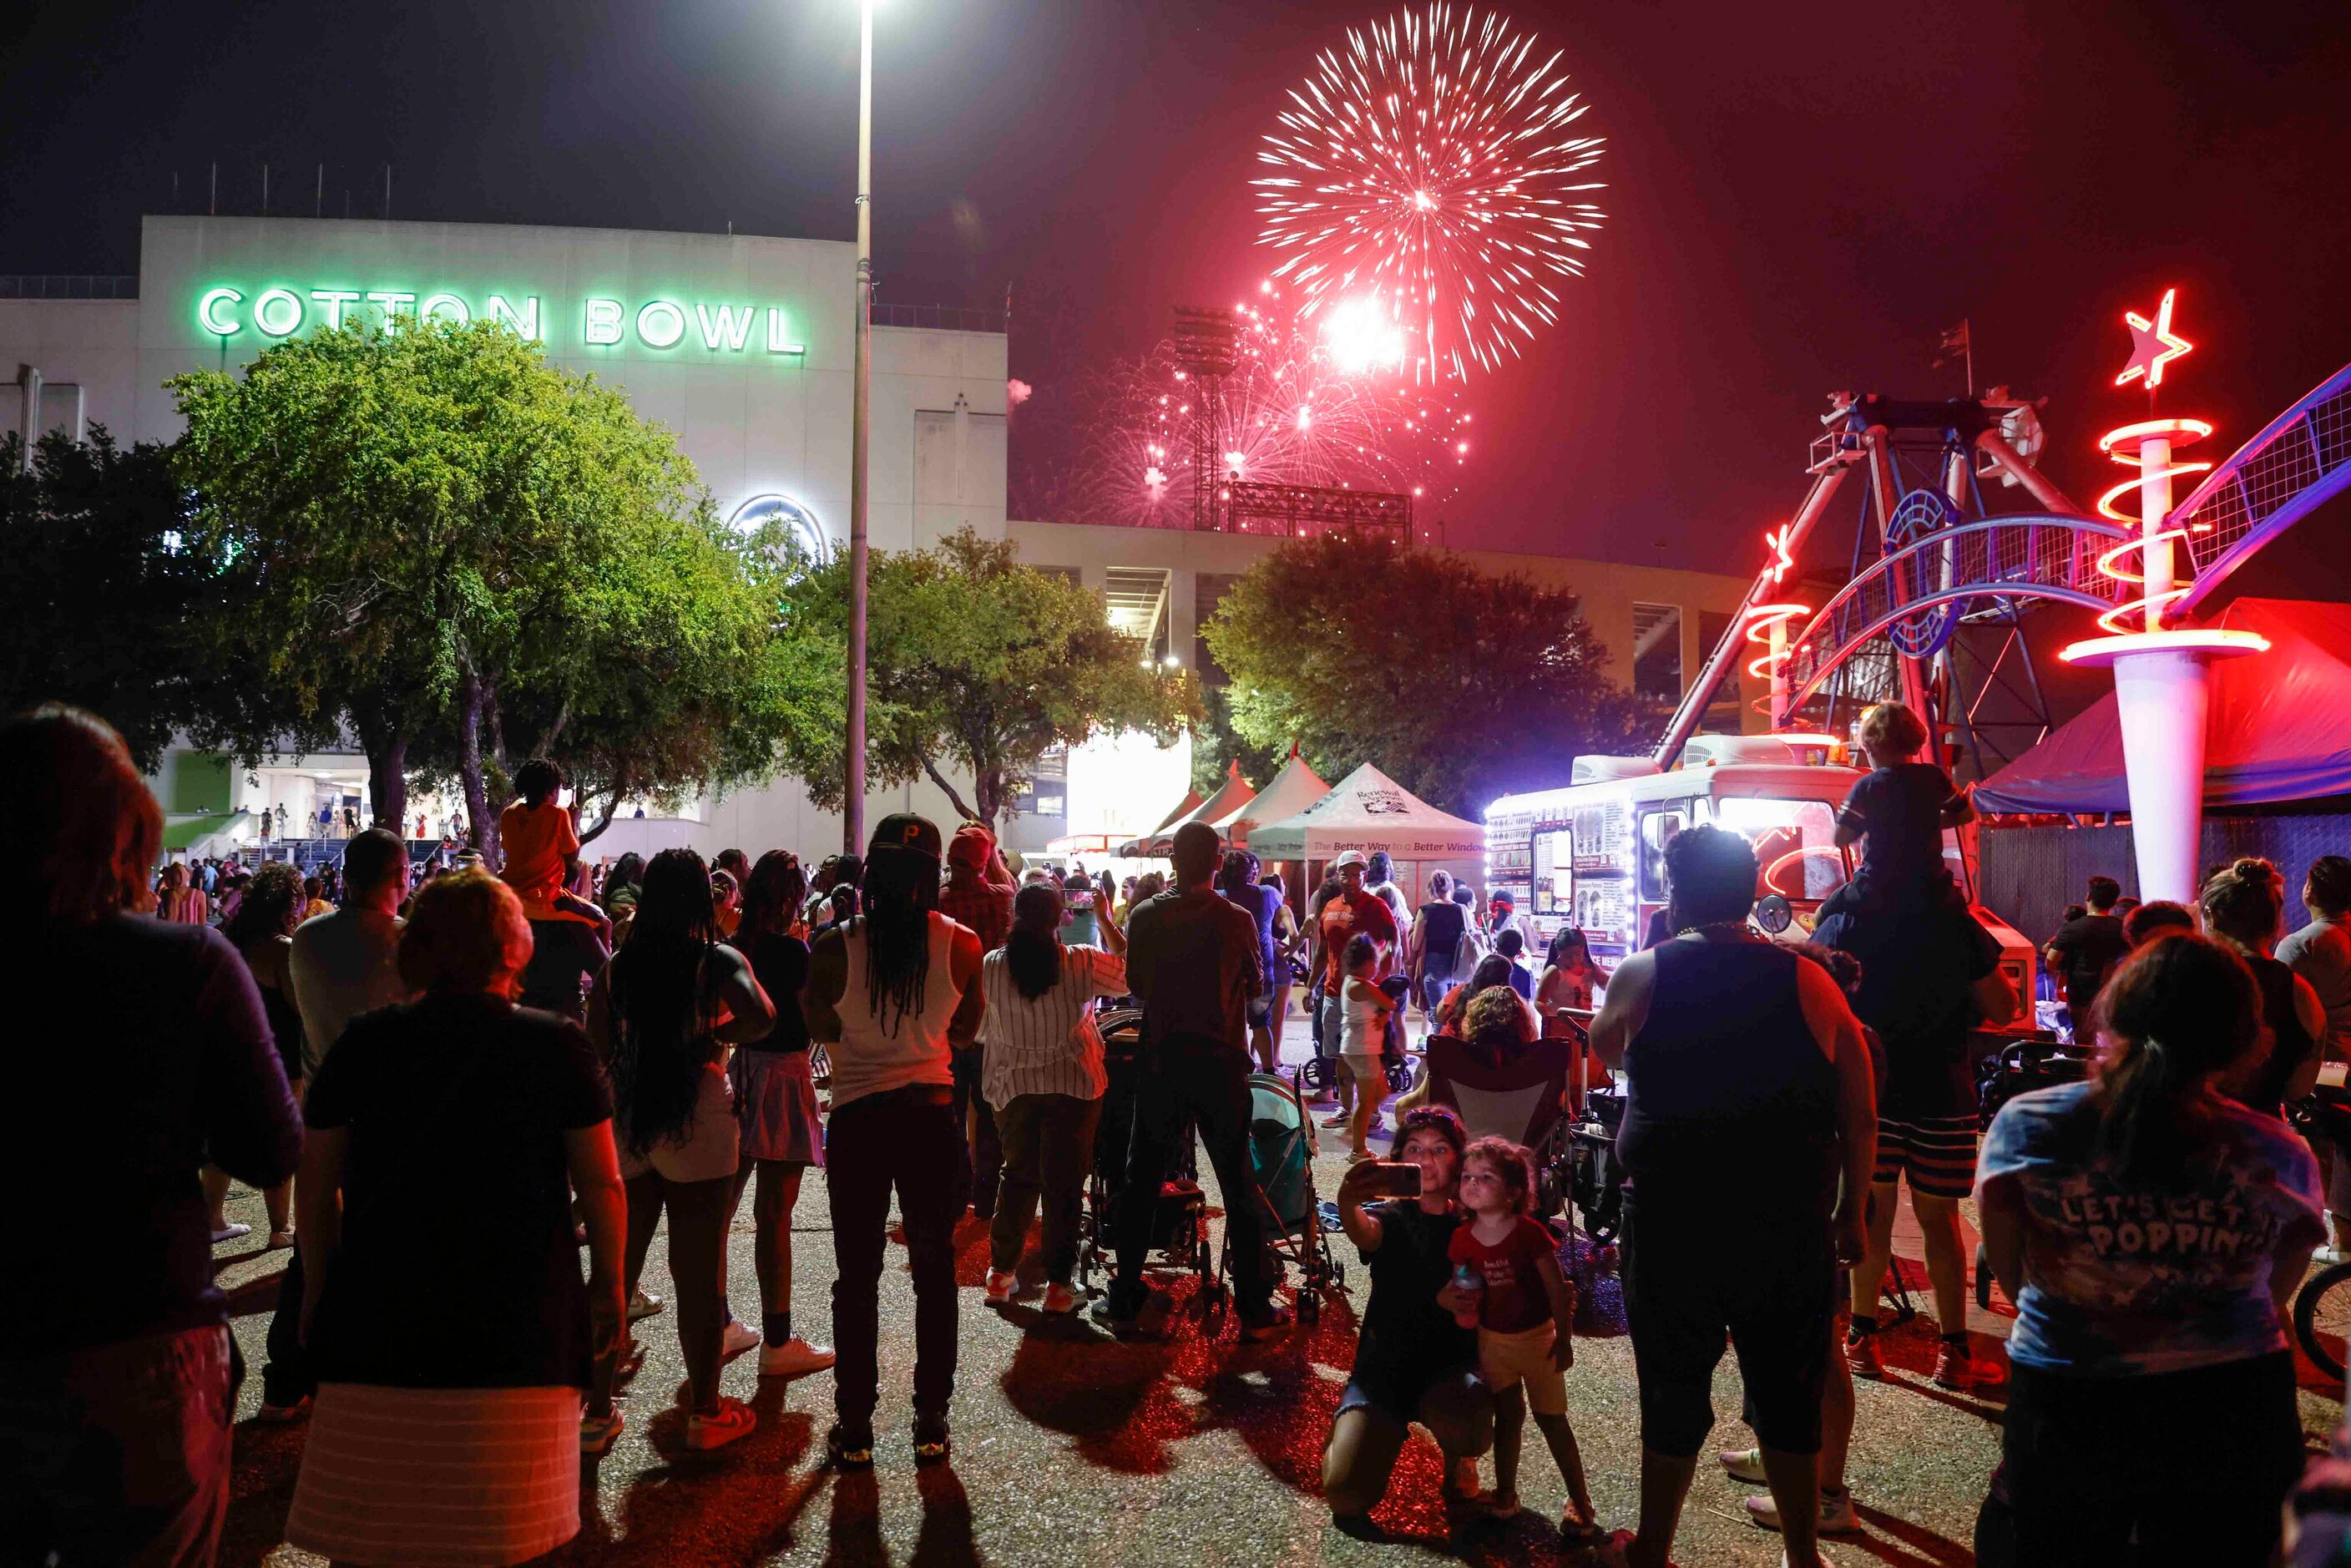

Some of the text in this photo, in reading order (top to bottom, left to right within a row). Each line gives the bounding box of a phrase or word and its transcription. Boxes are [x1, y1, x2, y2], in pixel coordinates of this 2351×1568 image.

[199, 288, 804, 355] COTTON BOWL
[1357, 790, 1400, 798] Renewal
[904, 824, 919, 844] P
[1314, 842, 1332, 851] The
[1333, 842, 1365, 851] Better
[1367, 842, 1391, 852] Way
[1393, 842, 1403, 851] to
[1413, 842, 1444, 852] Better
[2060, 1195, 2156, 1223] LET'S
